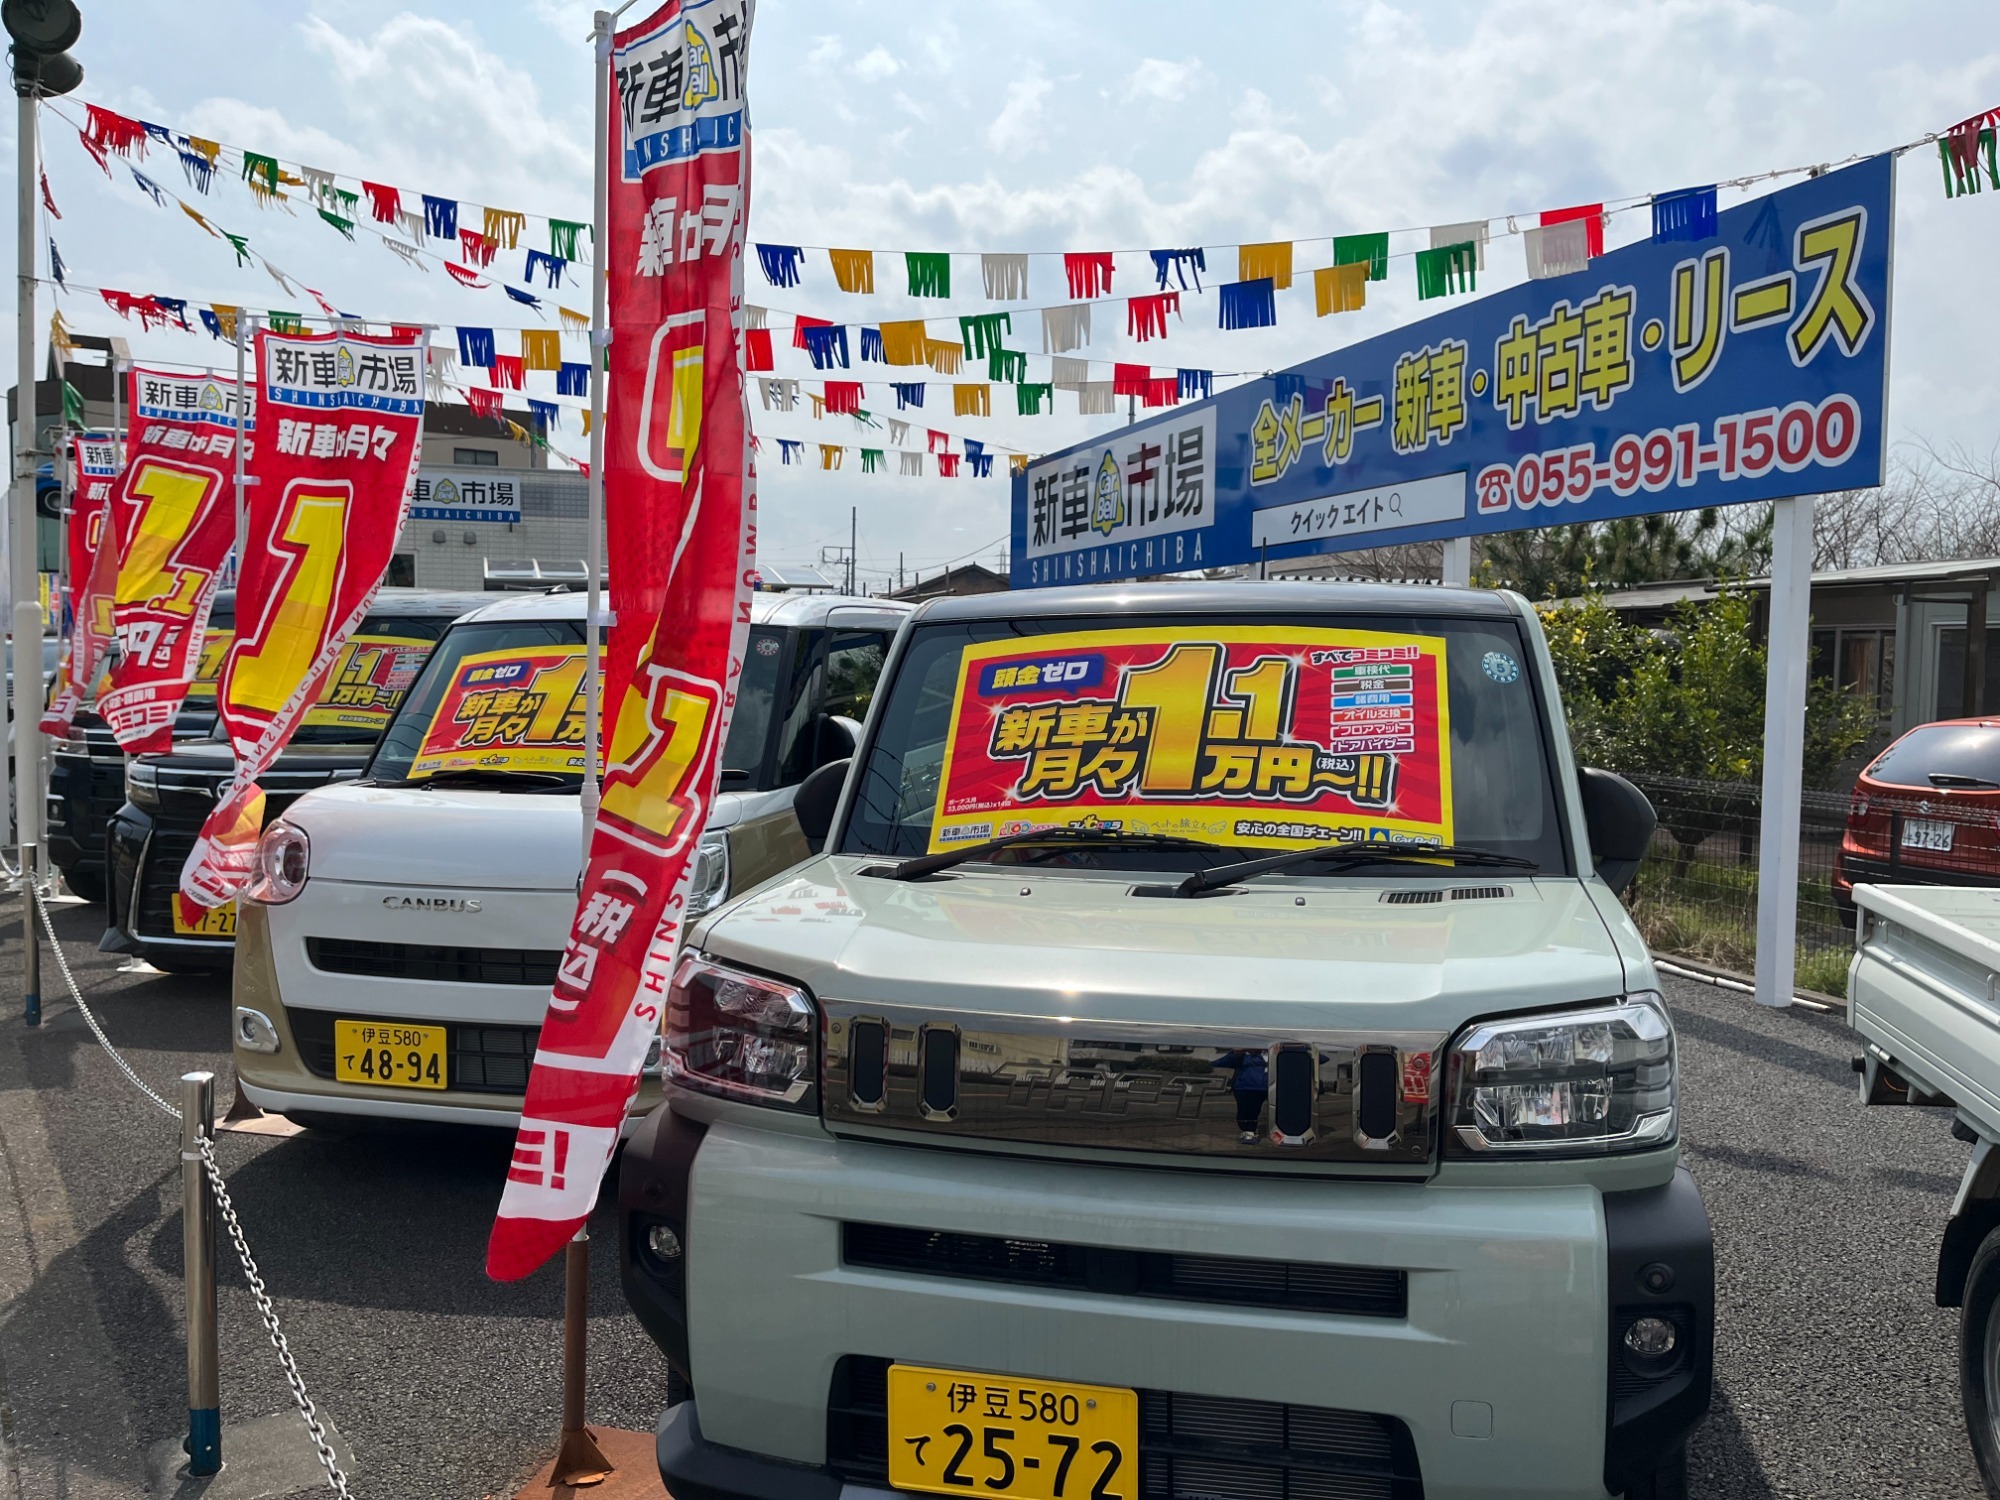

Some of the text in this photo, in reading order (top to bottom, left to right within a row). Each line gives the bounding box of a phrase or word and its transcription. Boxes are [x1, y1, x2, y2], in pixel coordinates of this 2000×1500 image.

[274, 347, 417, 395] 新車市場
[1253, 384, 1382, 482] 全メーカー
[1516, 401, 1856, 501] 055-991-1500
[1033, 426, 1204, 547] 新車市場
[1100, 470, 1117, 495] Car
[1096, 491, 1118, 523] Bell
[1032, 531, 1203, 584] SHINSHAICHIBA
[1311, 646, 1419, 665] すべてコミコミ!!
[1354, 664, 1391, 675] 車検代
[991, 660, 1089, 690] 頭金ゼロ
[1360, 680, 1385, 690] 税金
[457, 690, 543, 719] 新車が
[1342, 708, 1402, 720] オイル交換
[463, 715, 531, 742] 月々
[996, 704, 1149, 752] 新車が
[1340, 723, 1405, 736] フロアマット
[1337, 738, 1408, 753] ドアバイザー
[1021, 747, 1140, 793] 月々
[1316, 757, 1356, 771] (税込)
[1236, 821, 1363, 842] 安心の全国チェーン!!
[382, 896, 482, 914] CANBUS
[342, 1048, 440, 1084] て 48-94
[991, 1061, 1228, 1120] TAFT
[903, 1423, 1123, 1500] て 25-72
